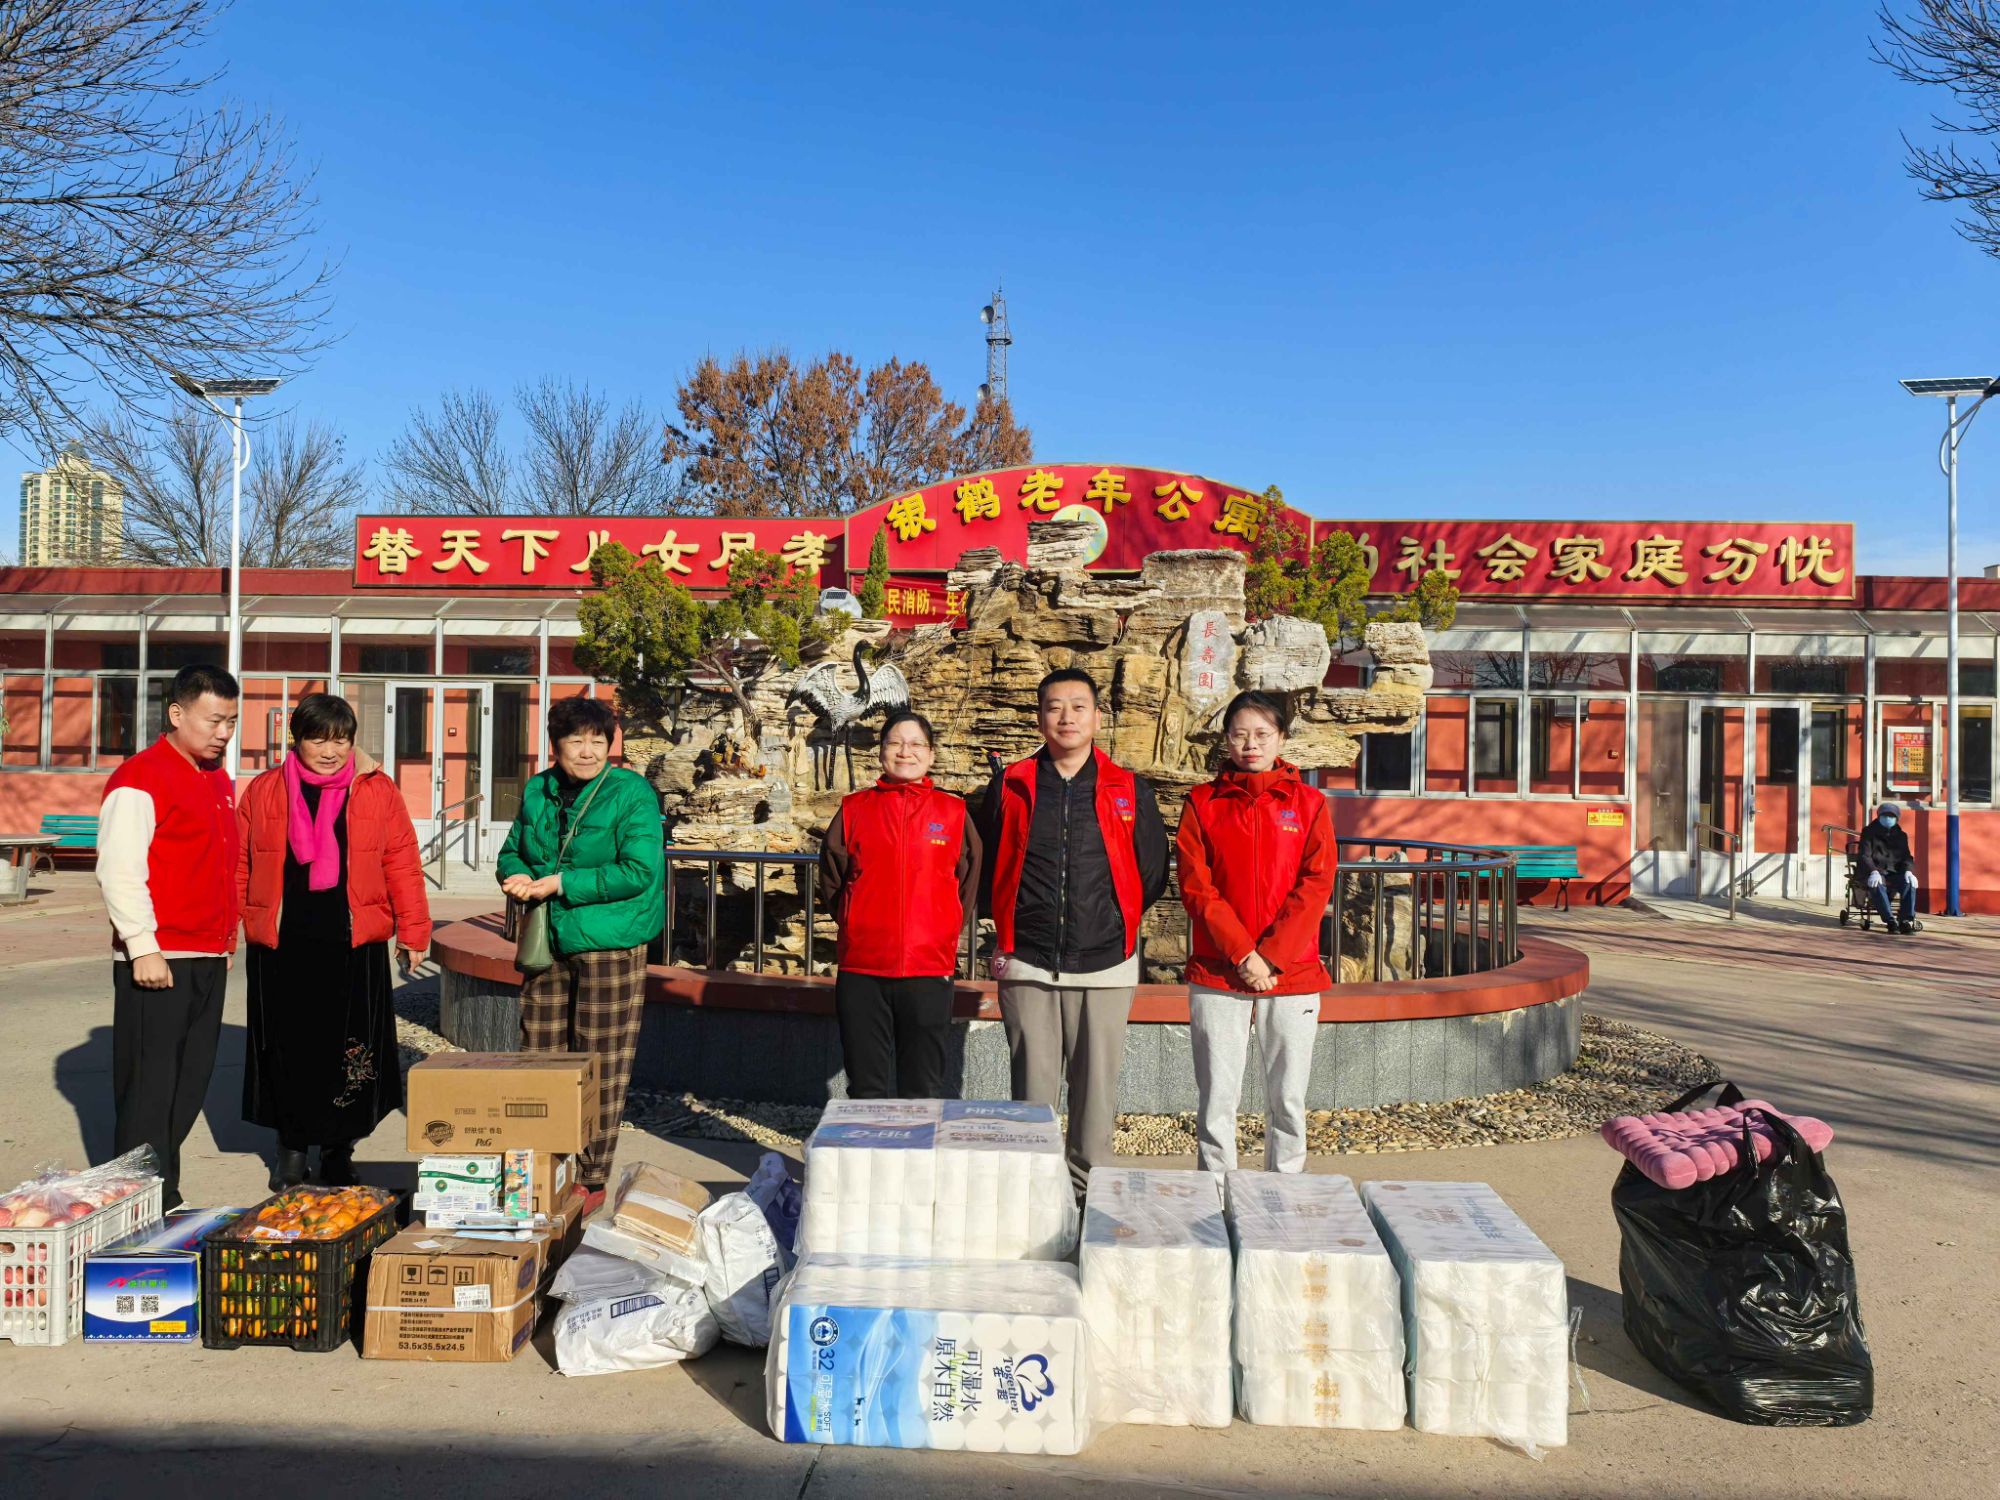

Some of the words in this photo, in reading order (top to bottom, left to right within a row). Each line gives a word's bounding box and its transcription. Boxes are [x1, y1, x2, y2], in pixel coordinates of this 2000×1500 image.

[886, 467, 1267, 543] 银鹤老年公寓
[818, 1348, 835, 1371] 32
[931, 1336, 957, 1423] 原木自然
[960, 1350, 983, 1412] 可湿水
[1002, 1357, 1020, 1413] Together
[823, 1411, 832, 1433] SOFT
